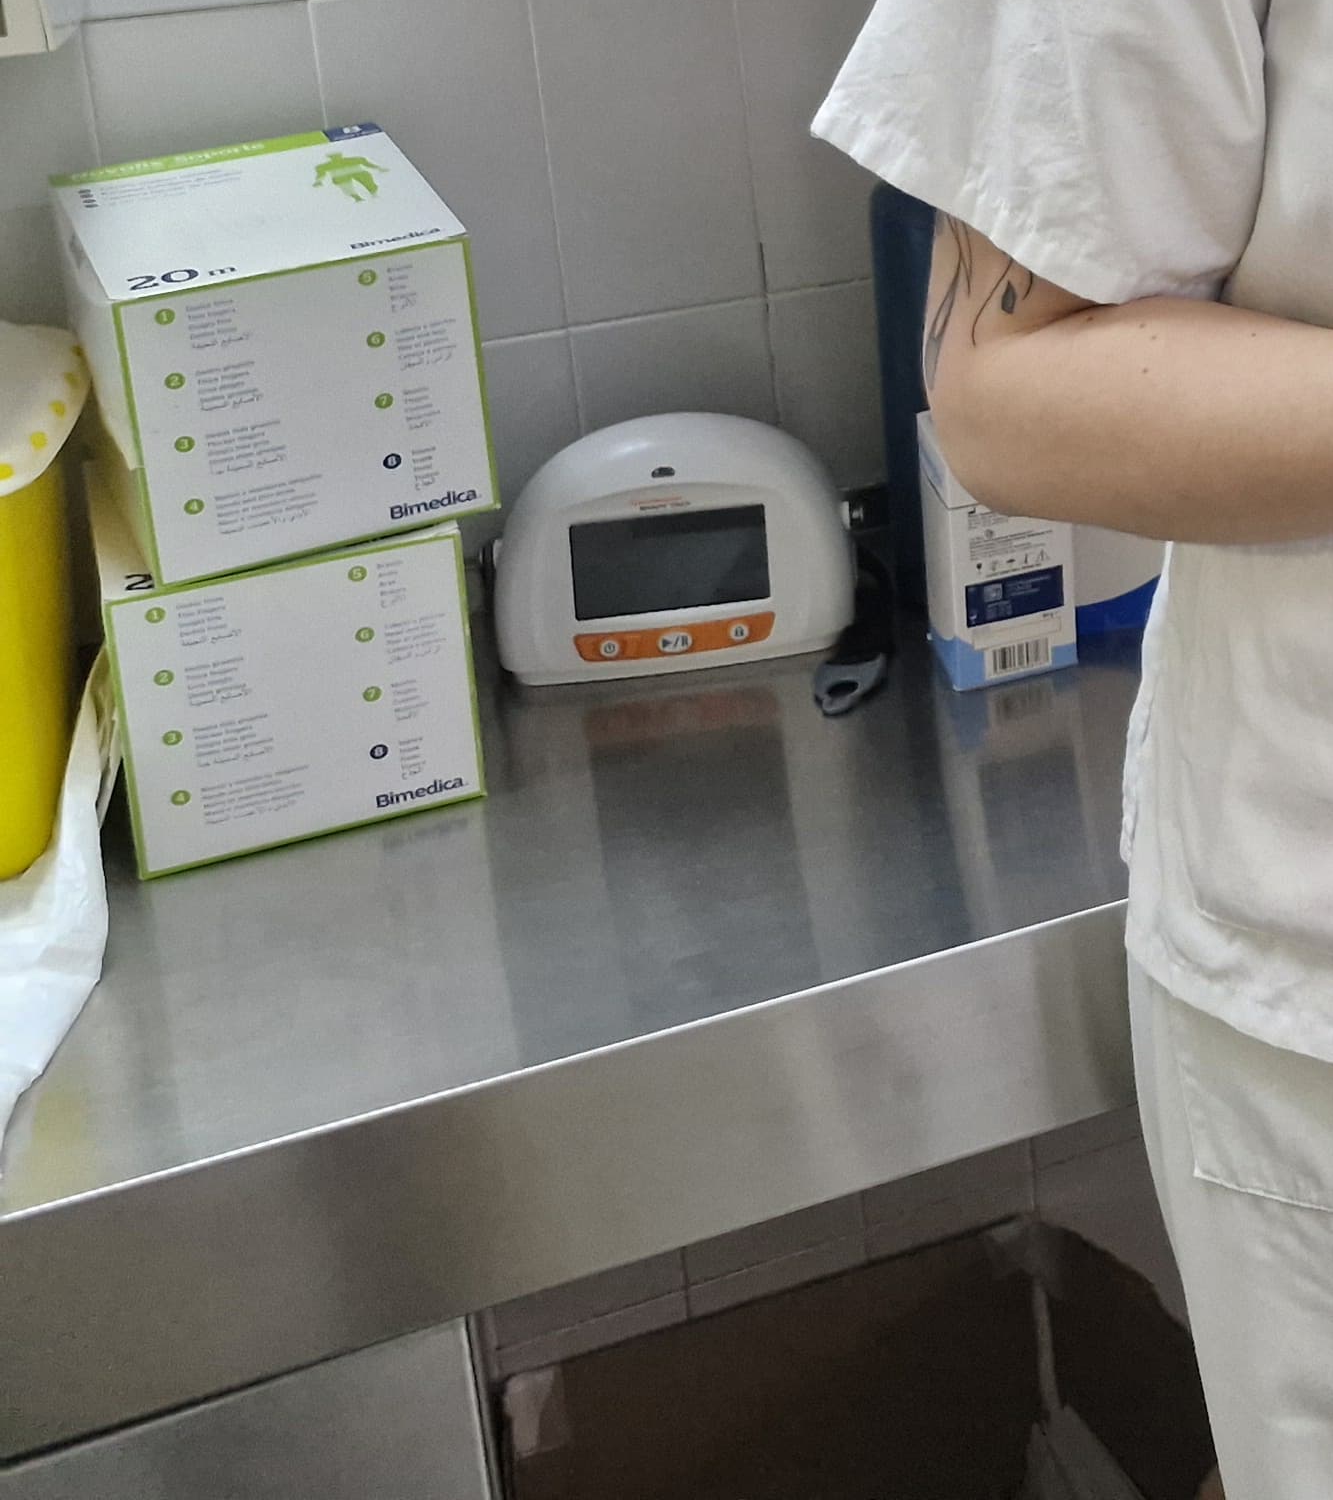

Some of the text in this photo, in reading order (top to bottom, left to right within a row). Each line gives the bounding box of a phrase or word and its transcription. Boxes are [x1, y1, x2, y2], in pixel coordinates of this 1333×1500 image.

[349, 226, 440, 251] Bimedica
[127, 264, 238, 293] 20 m
[389, 488, 479, 521] Bimedica
[375, 775, 466, 809] Bimedica
